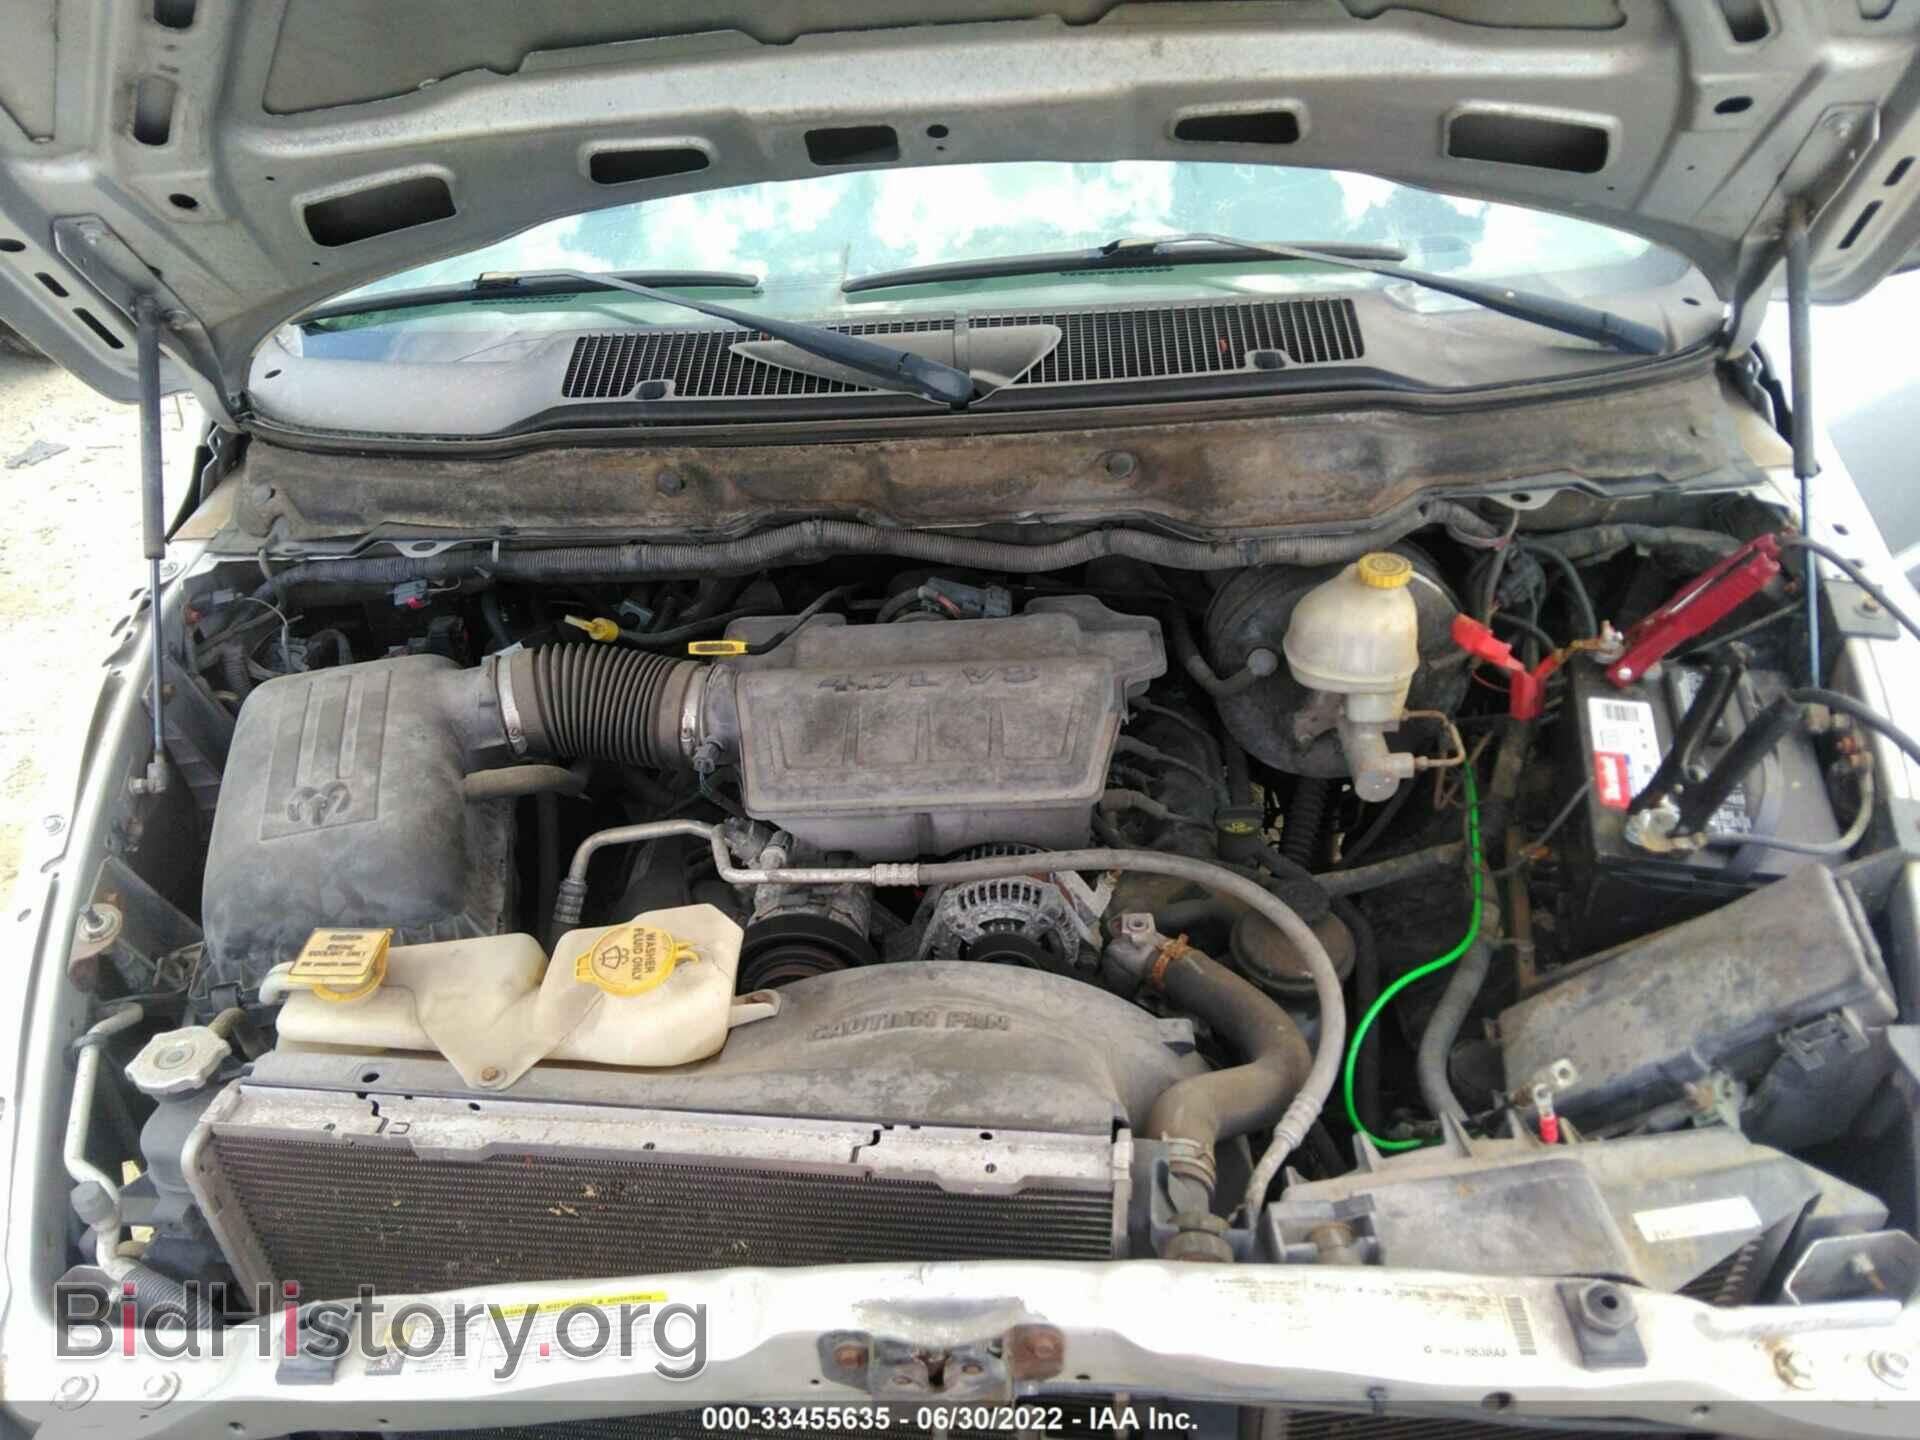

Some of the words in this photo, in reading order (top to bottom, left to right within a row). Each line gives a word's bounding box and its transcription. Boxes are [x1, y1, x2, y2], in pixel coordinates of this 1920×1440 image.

[632, 927, 644, 955] FLUID
[644, 931, 657, 974] WASHER
[631, 957, 642, 980] ONLY
